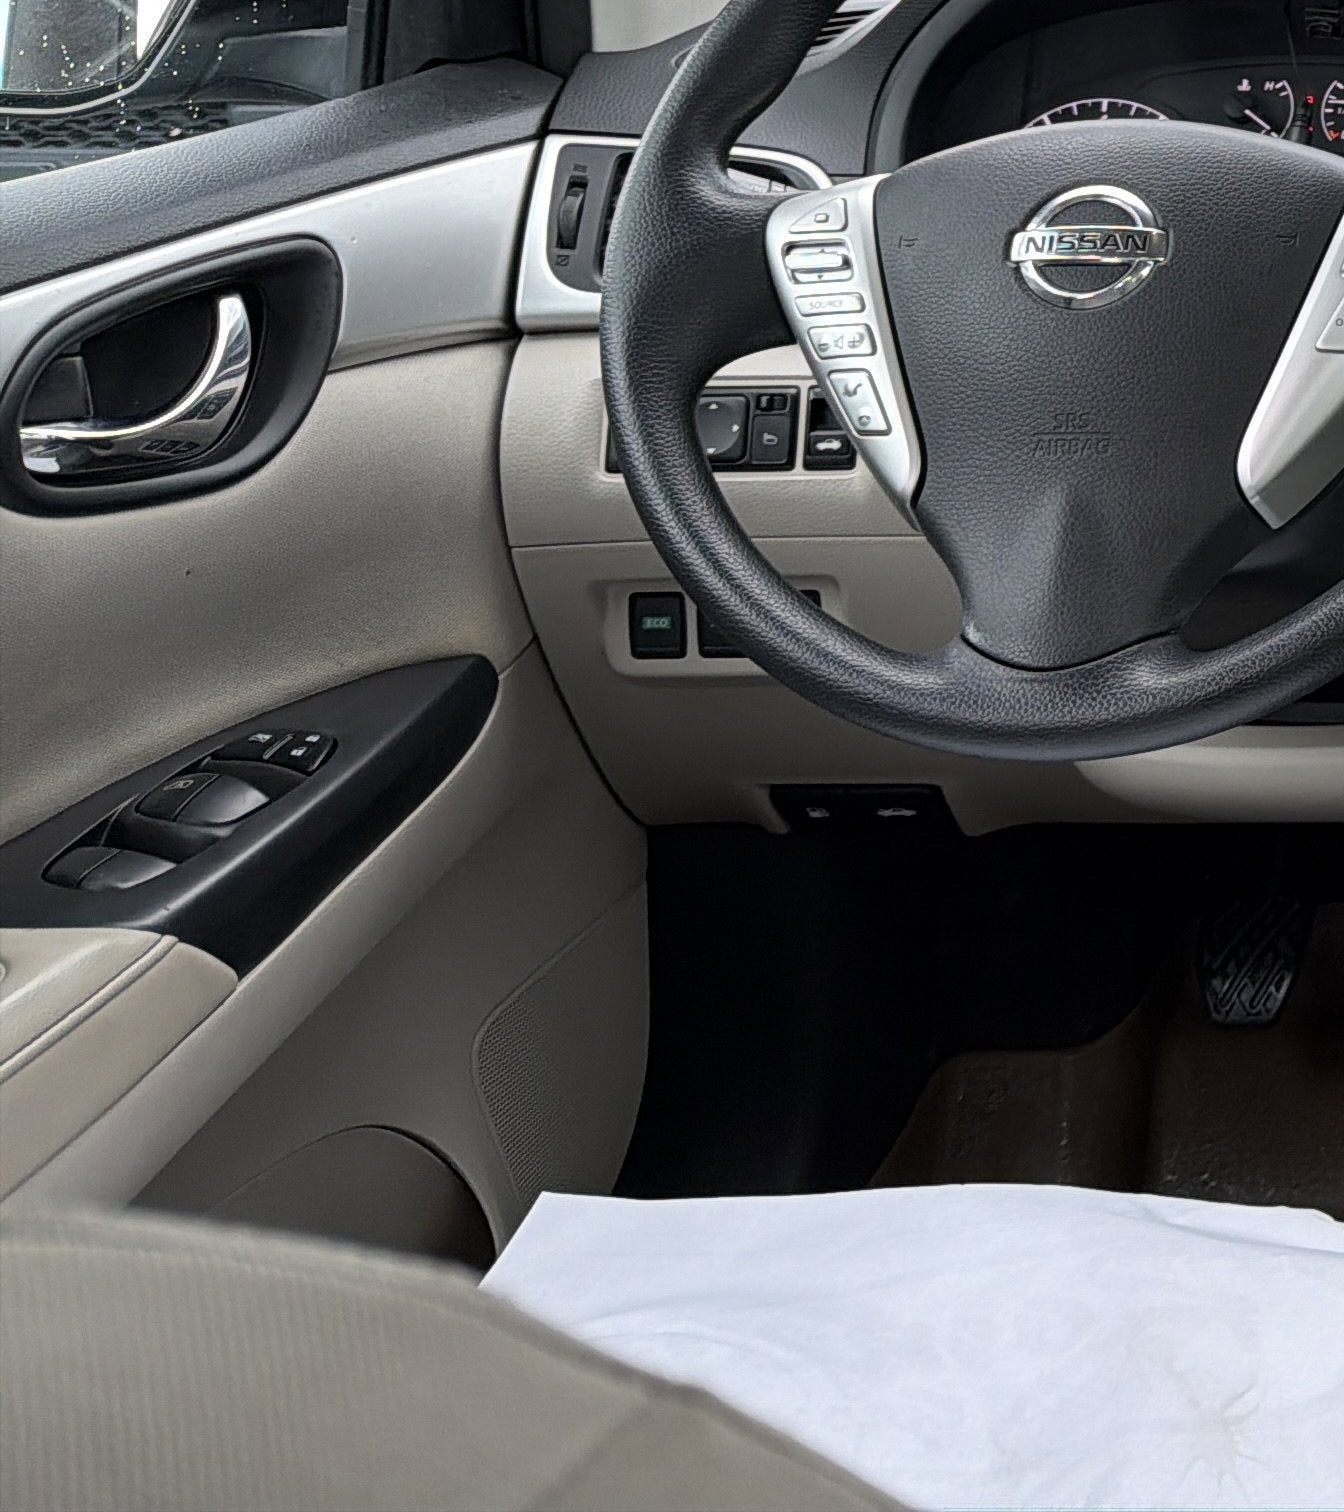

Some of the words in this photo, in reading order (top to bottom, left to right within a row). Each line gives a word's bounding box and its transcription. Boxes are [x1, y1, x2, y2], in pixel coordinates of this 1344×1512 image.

[1024, 231, 1150, 255] NISSAN
[1053, 411, 1090, 431] SRS
[1032, 437, 1111, 458] AIRBAG
